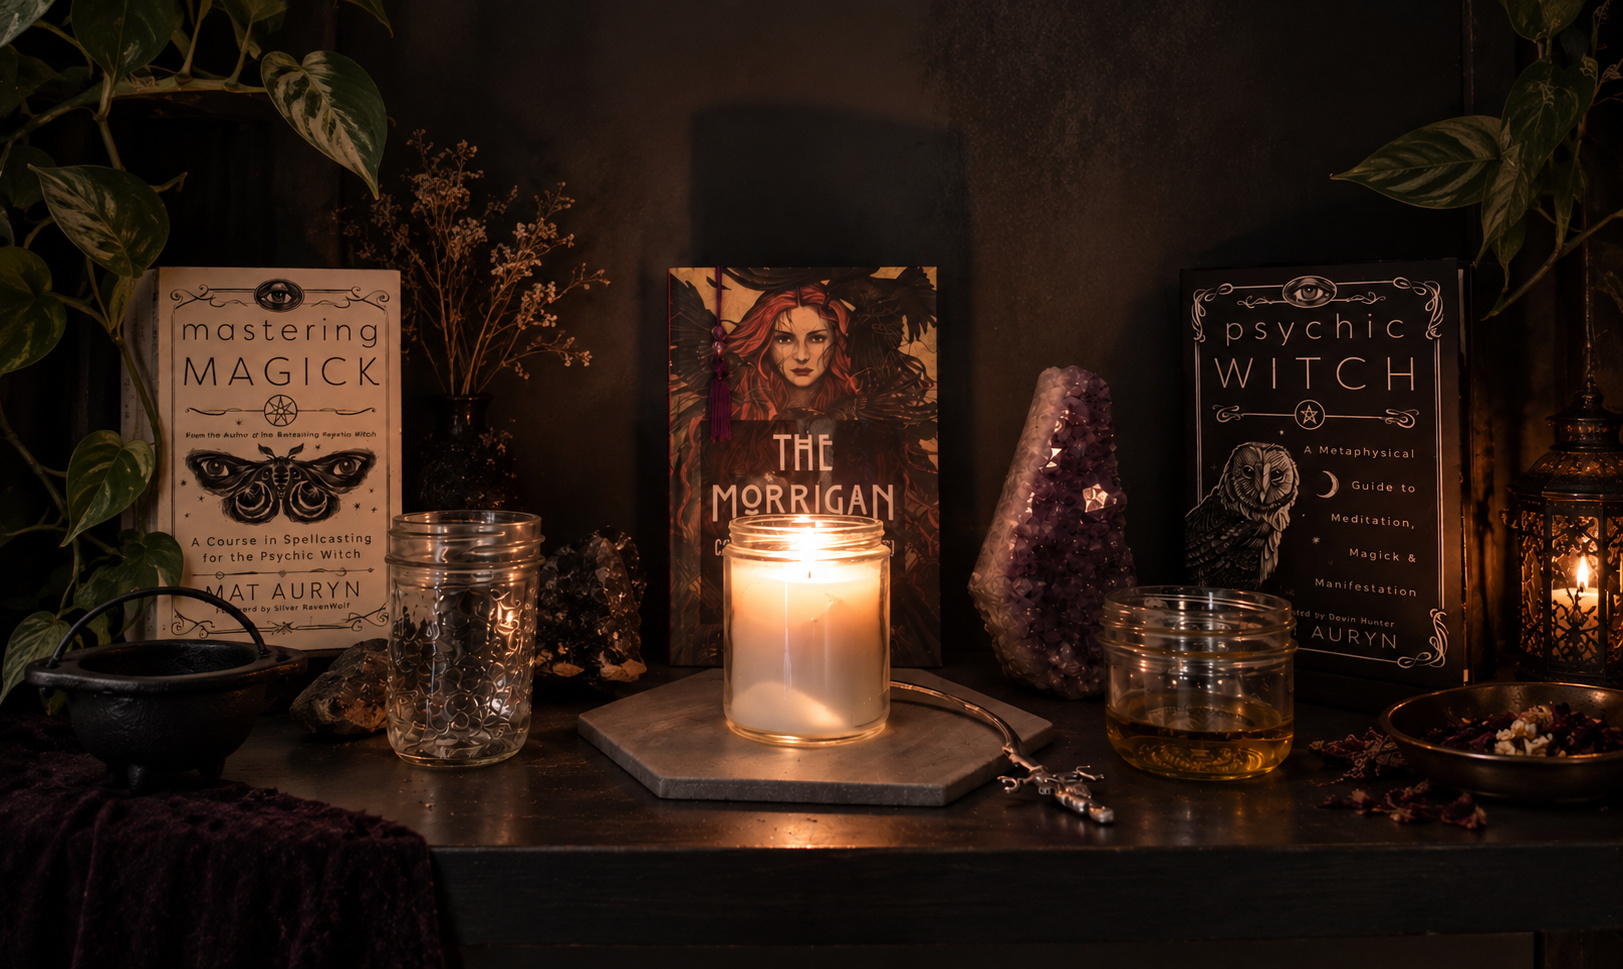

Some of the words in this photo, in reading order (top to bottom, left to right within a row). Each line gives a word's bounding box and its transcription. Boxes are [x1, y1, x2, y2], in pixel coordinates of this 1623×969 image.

[183, 318, 377, 348] mastering
[1226, 313, 1404, 347] psychic
[184, 357, 379, 386] MAGICK
[1214, 357, 1414, 391] WITCH
[773, 434, 833, 471] THE
[1304, 446, 1311, 454] A
[1319, 445, 1414, 459] Metaphysical
[1351, 480, 1393, 492] Guide
[1401, 483, 1416, 493] to
[712, 484, 893, 522] MORRIGAN
[1331, 513, 1415, 529] Meditation,
[191, 537, 200, 547] A
[207, 536, 257, 547] Course
[264, 535, 277, 545] in
[284, 533, 372, 546] Spellcasting
[203, 553, 223, 563] for
[231, 552, 253, 562] the
[261, 550, 313, 563] Psychic
[320, 549, 361, 560] Witch
[1349, 548, 1399, 562] Magick
[1408, 554, 1416, 563] &
[206, 584, 259, 602] MAT
[272, 581, 359, 600] AURYN
[1314, 578, 1417, 597] Manifestation
[260, 605, 271, 614] by
[274, 604, 299, 612] Silver
[303, 602, 350, 611] RavenWolf
[1315, 612, 1325, 620] by
[1361, 617, 1395, 628] Hunter
[1311, 626, 1396, 649] AURYN
